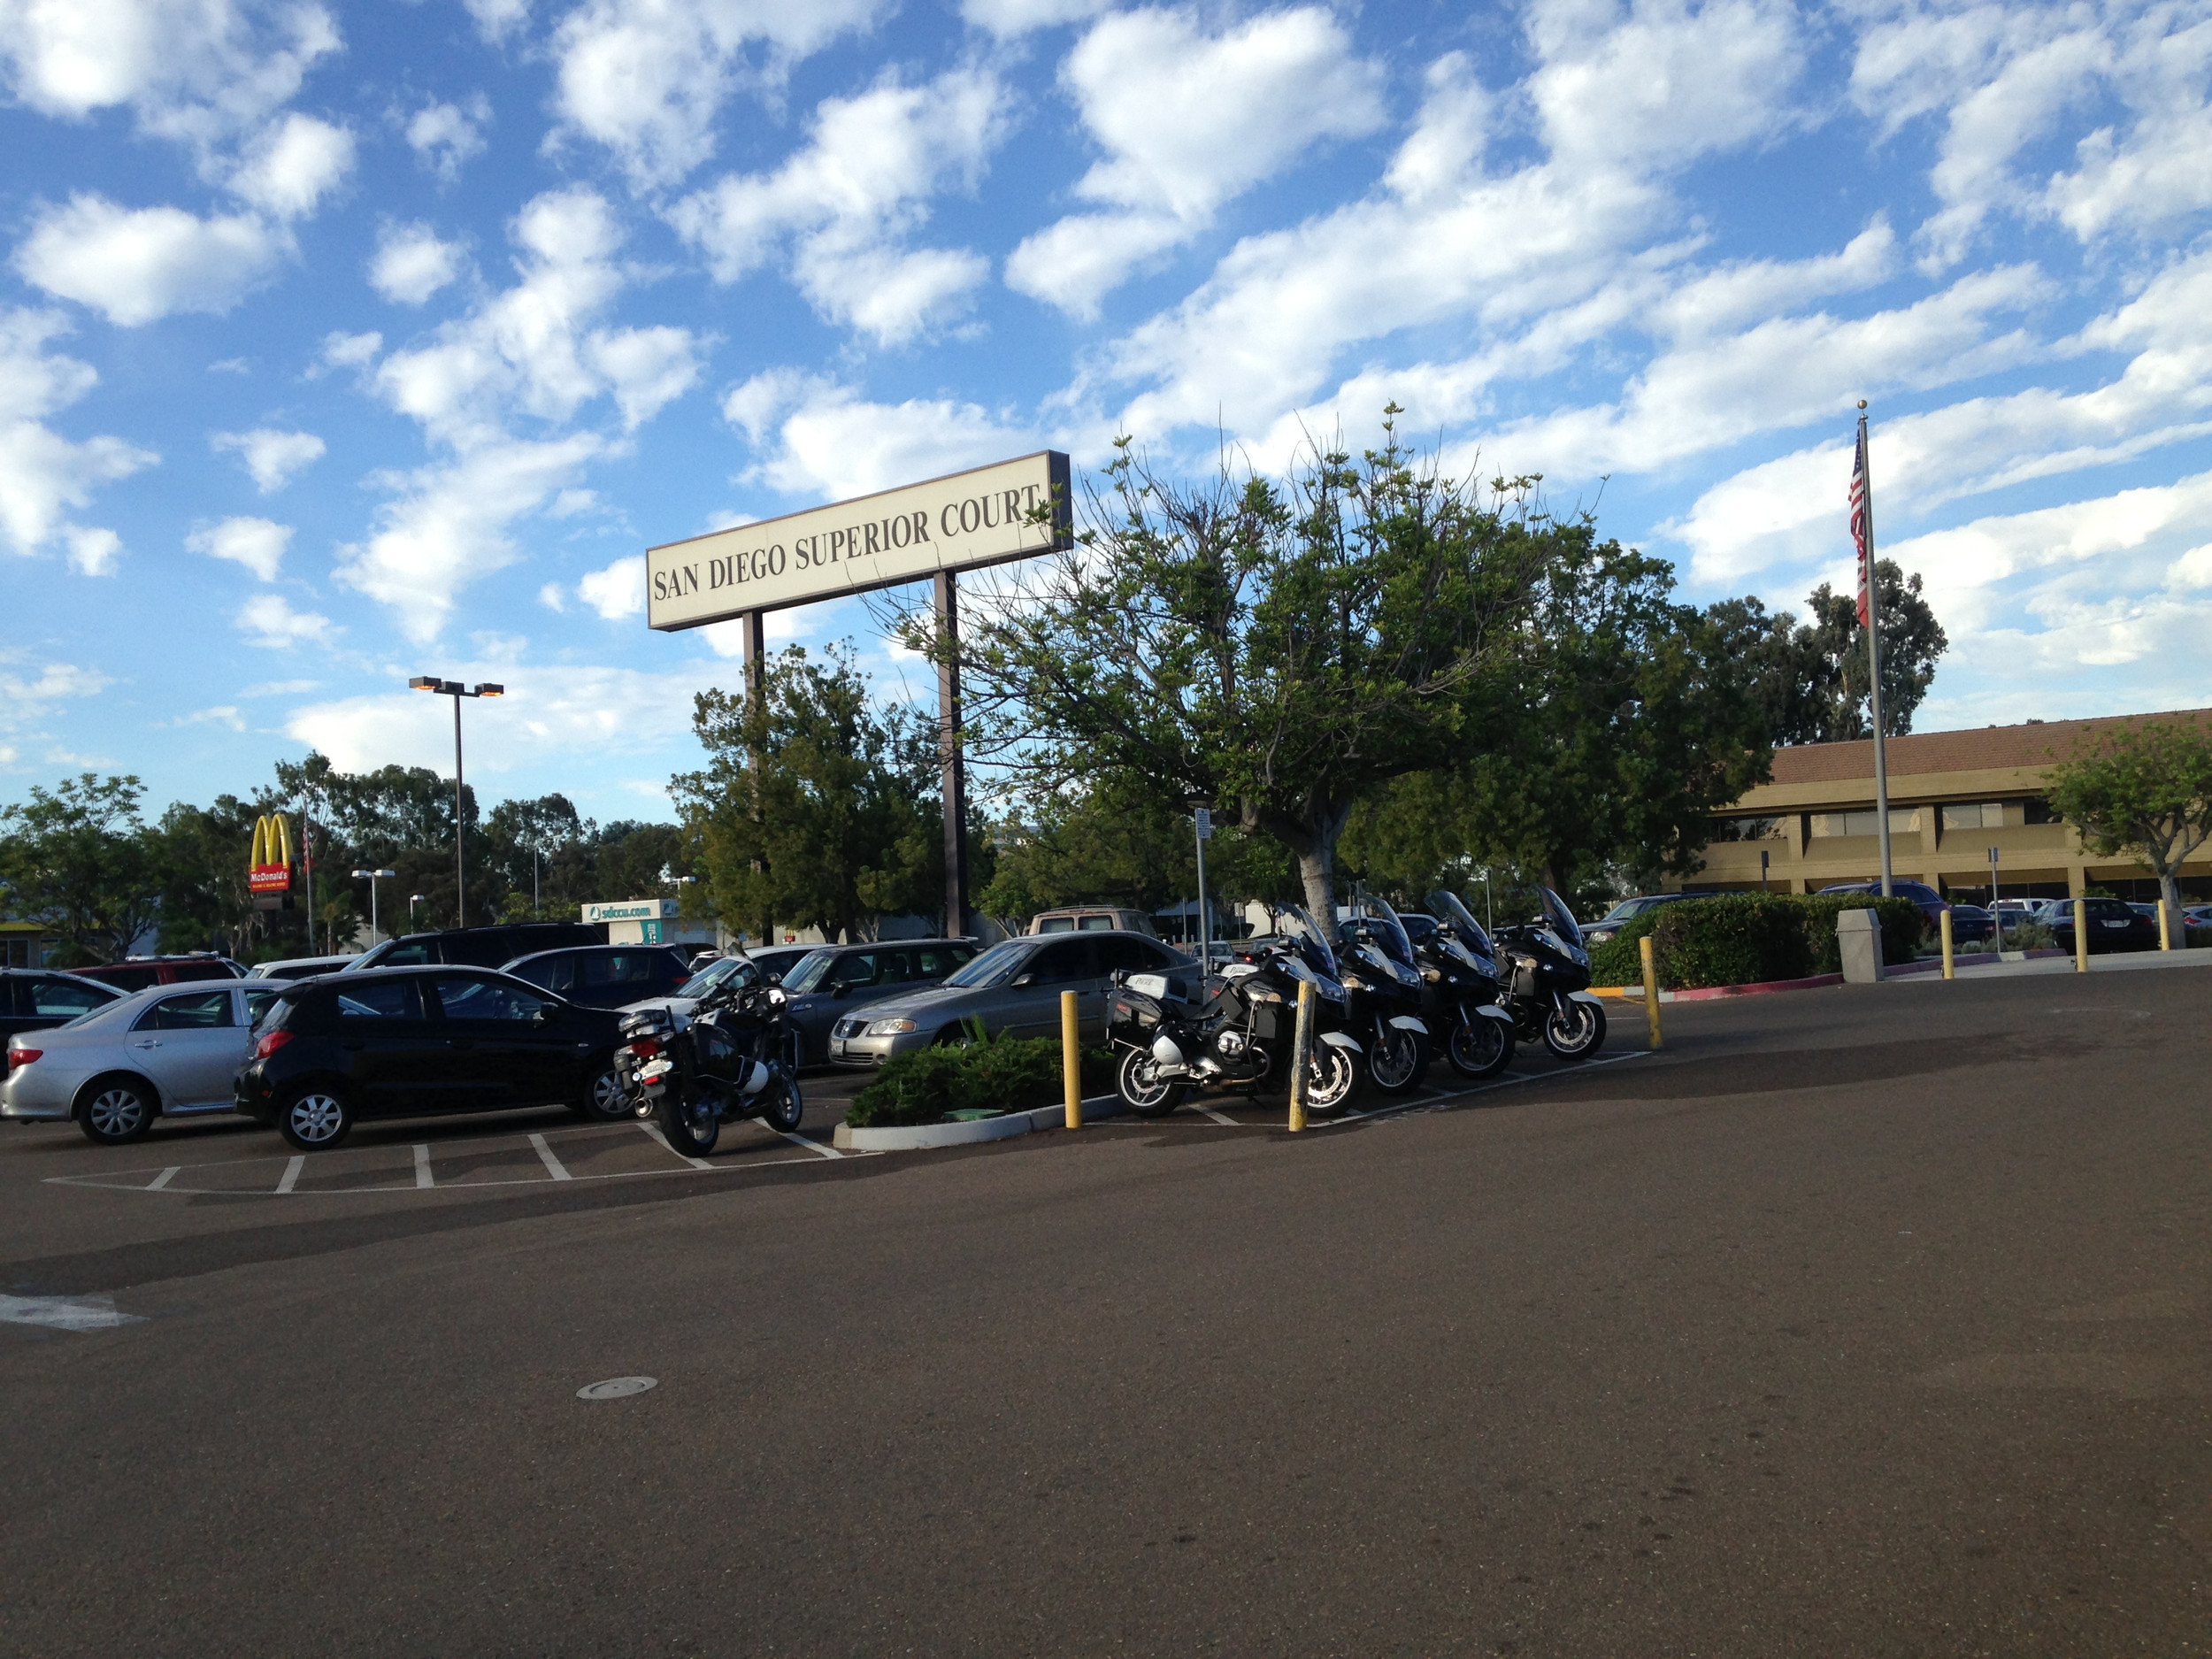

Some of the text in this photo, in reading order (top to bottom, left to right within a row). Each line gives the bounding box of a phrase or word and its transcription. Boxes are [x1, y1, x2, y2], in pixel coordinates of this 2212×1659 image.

[655, 483, 1041, 601] SAN DIEGO SUPERIOR COURT
[250, 872, 288, 881] McDonald's
[602, 906, 651, 918] sdccu.com
